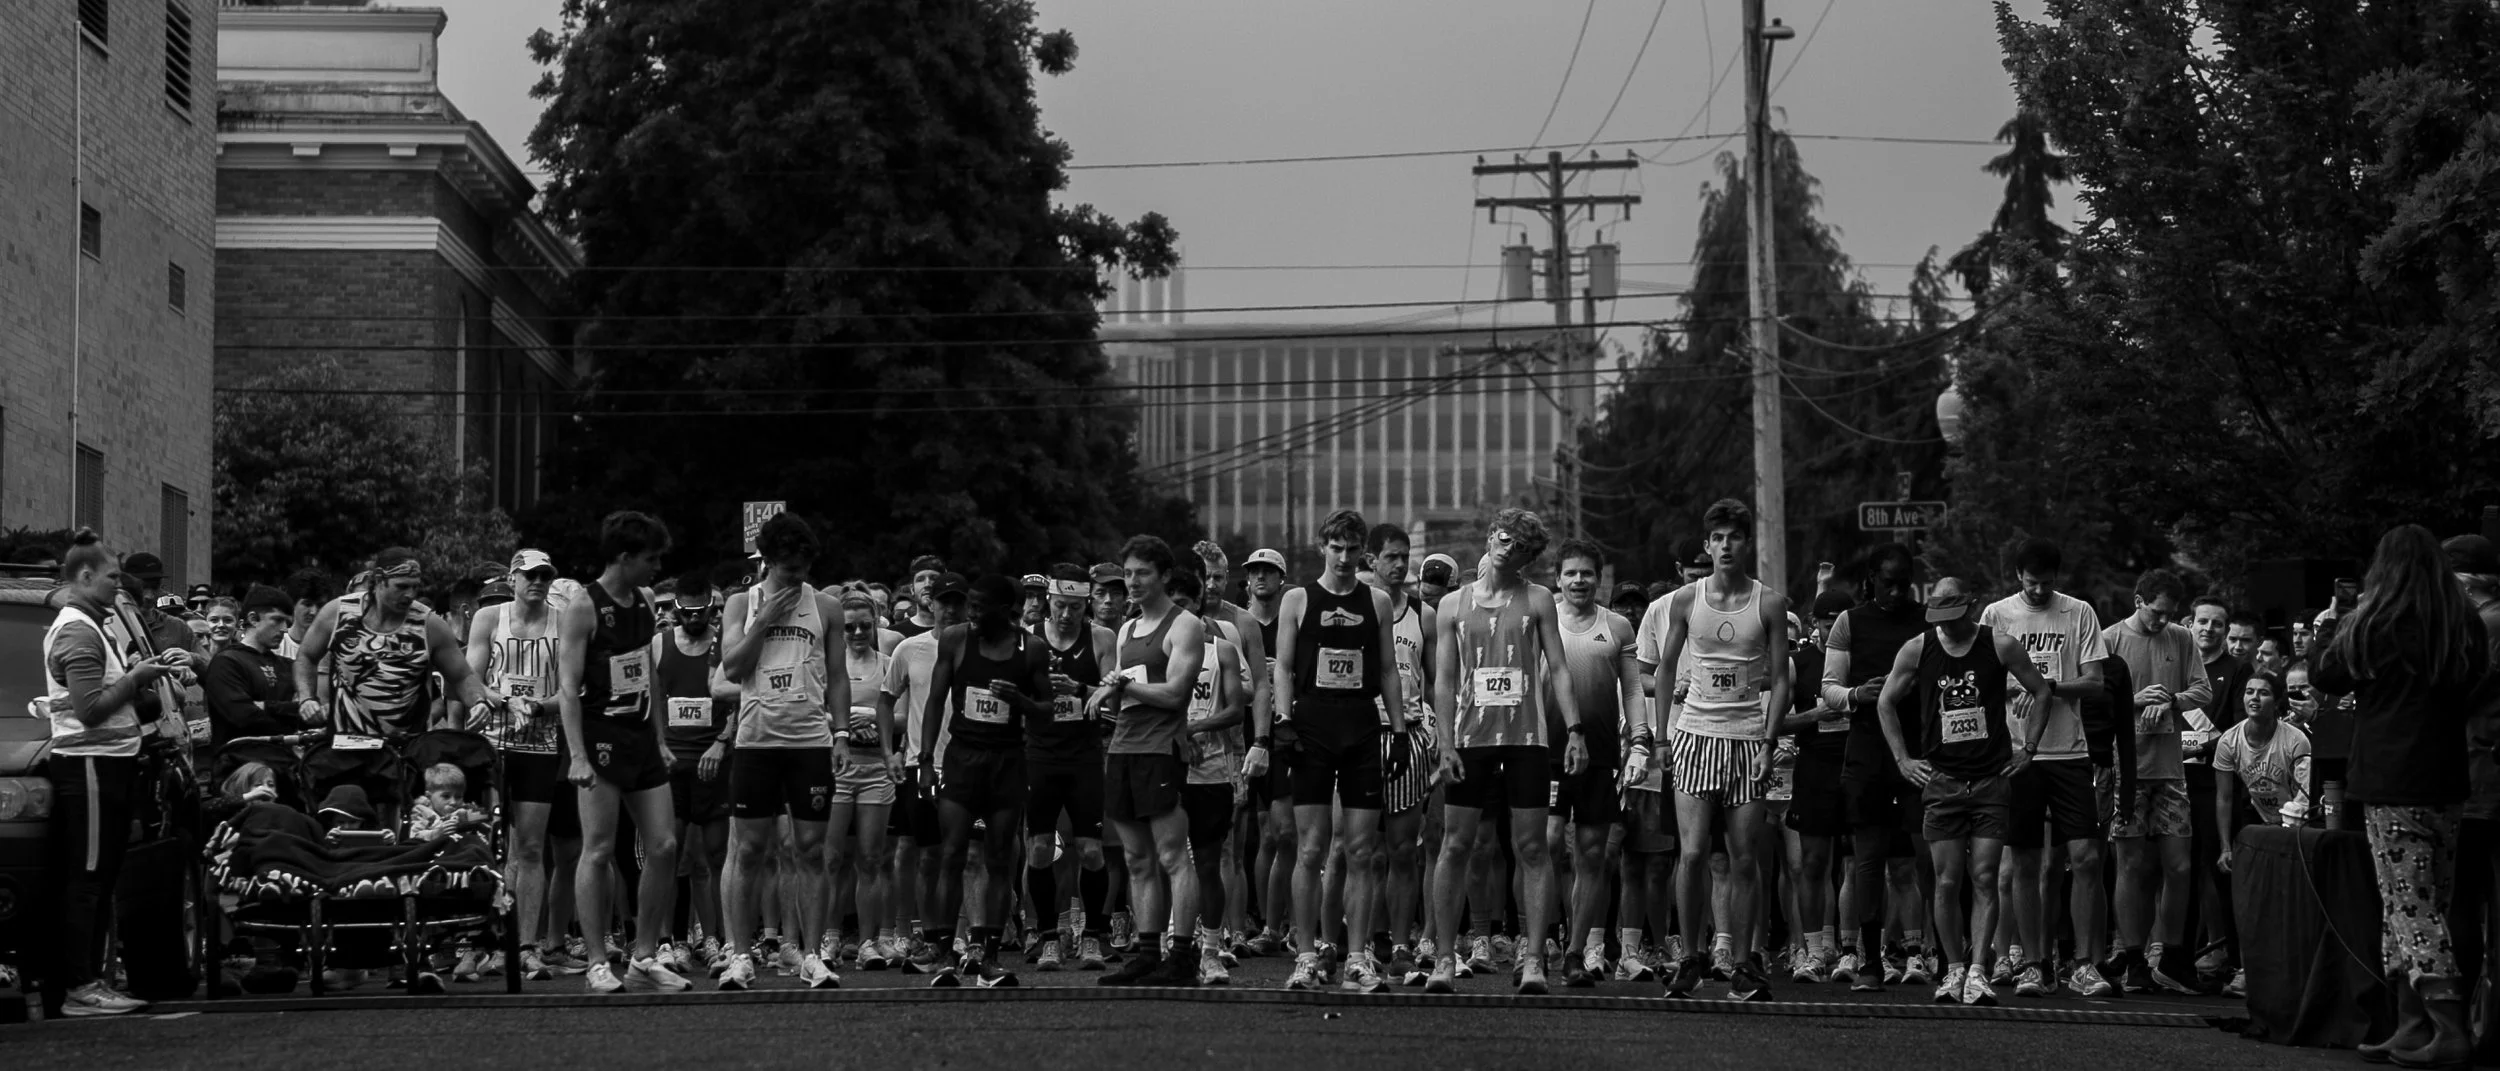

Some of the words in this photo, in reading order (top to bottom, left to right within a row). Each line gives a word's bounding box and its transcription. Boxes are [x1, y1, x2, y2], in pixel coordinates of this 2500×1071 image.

[1866, 507, 1889, 526] 8th
[1893, 506, 1919, 525] Ave
[1395, 635, 1417, 652] park
[1328, 659, 1354, 674] 1278
[769, 673, 793, 689] 1317
[1485, 677, 1511, 691] 1279
[1711, 673, 1736, 687] 2161
[678, 706, 702, 719] 1475
[975, 699, 999, 714] 1134
[1950, 718, 1978, 734] 2333
